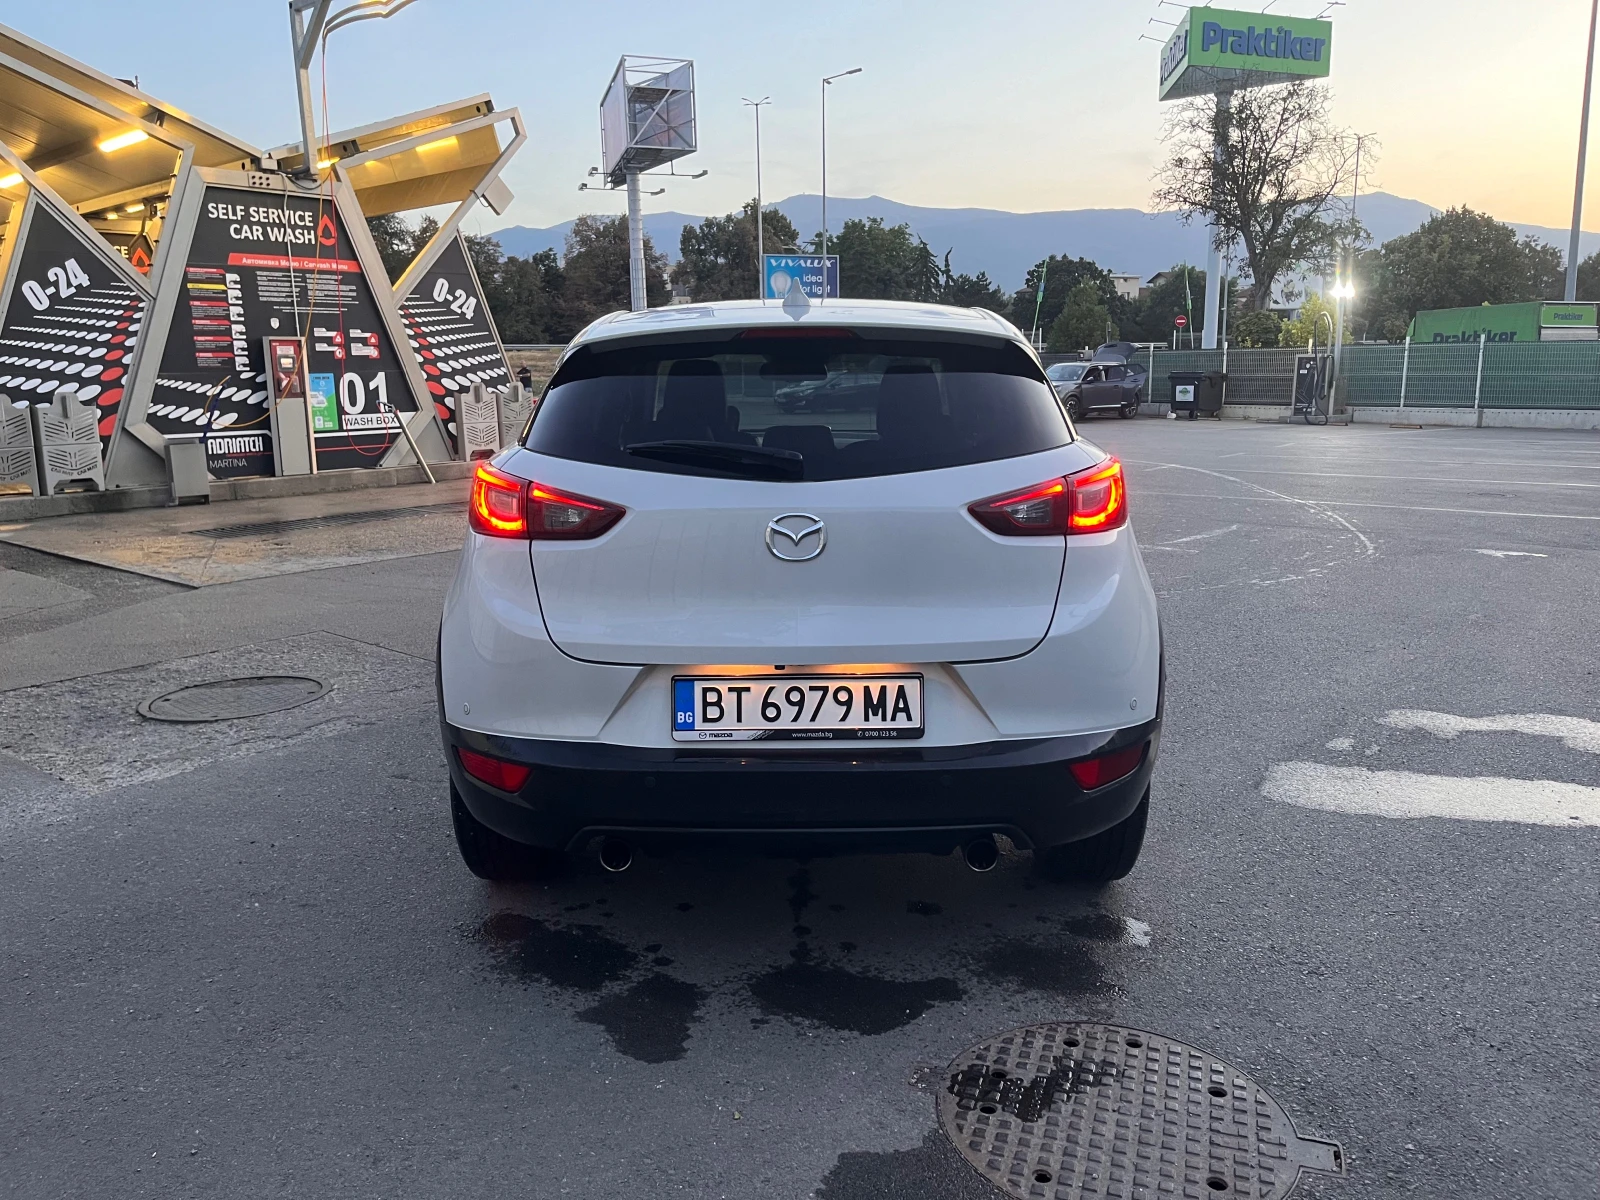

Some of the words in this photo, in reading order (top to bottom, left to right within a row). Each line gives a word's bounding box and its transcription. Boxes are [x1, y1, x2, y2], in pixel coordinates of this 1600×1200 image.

[1202, 21, 1326, 62] Praktiker
[208, 203, 245, 221] SELF
[249, 206, 314, 226] SERVICE
[229, 224, 264, 241] CAR
[266, 226, 316, 245] WASH
[770, 259, 836, 267] VIVALUX
[21, 257, 91, 311] 0-24
[803, 273, 823, 283] idea
[432, 277, 478, 320] 0-24
[1553, 312, 1583, 321] Praktiker
[339, 371, 389, 415] 01
[345, 416, 374, 427] WASH
[376, 415, 397, 425] BOX
[209, 458, 248, 469] MARTINA
[701, 686, 751, 724] BT
[760, 685, 854, 723] 6979
[863, 684, 913, 723] MA
[677, 711, 693, 724] BG
